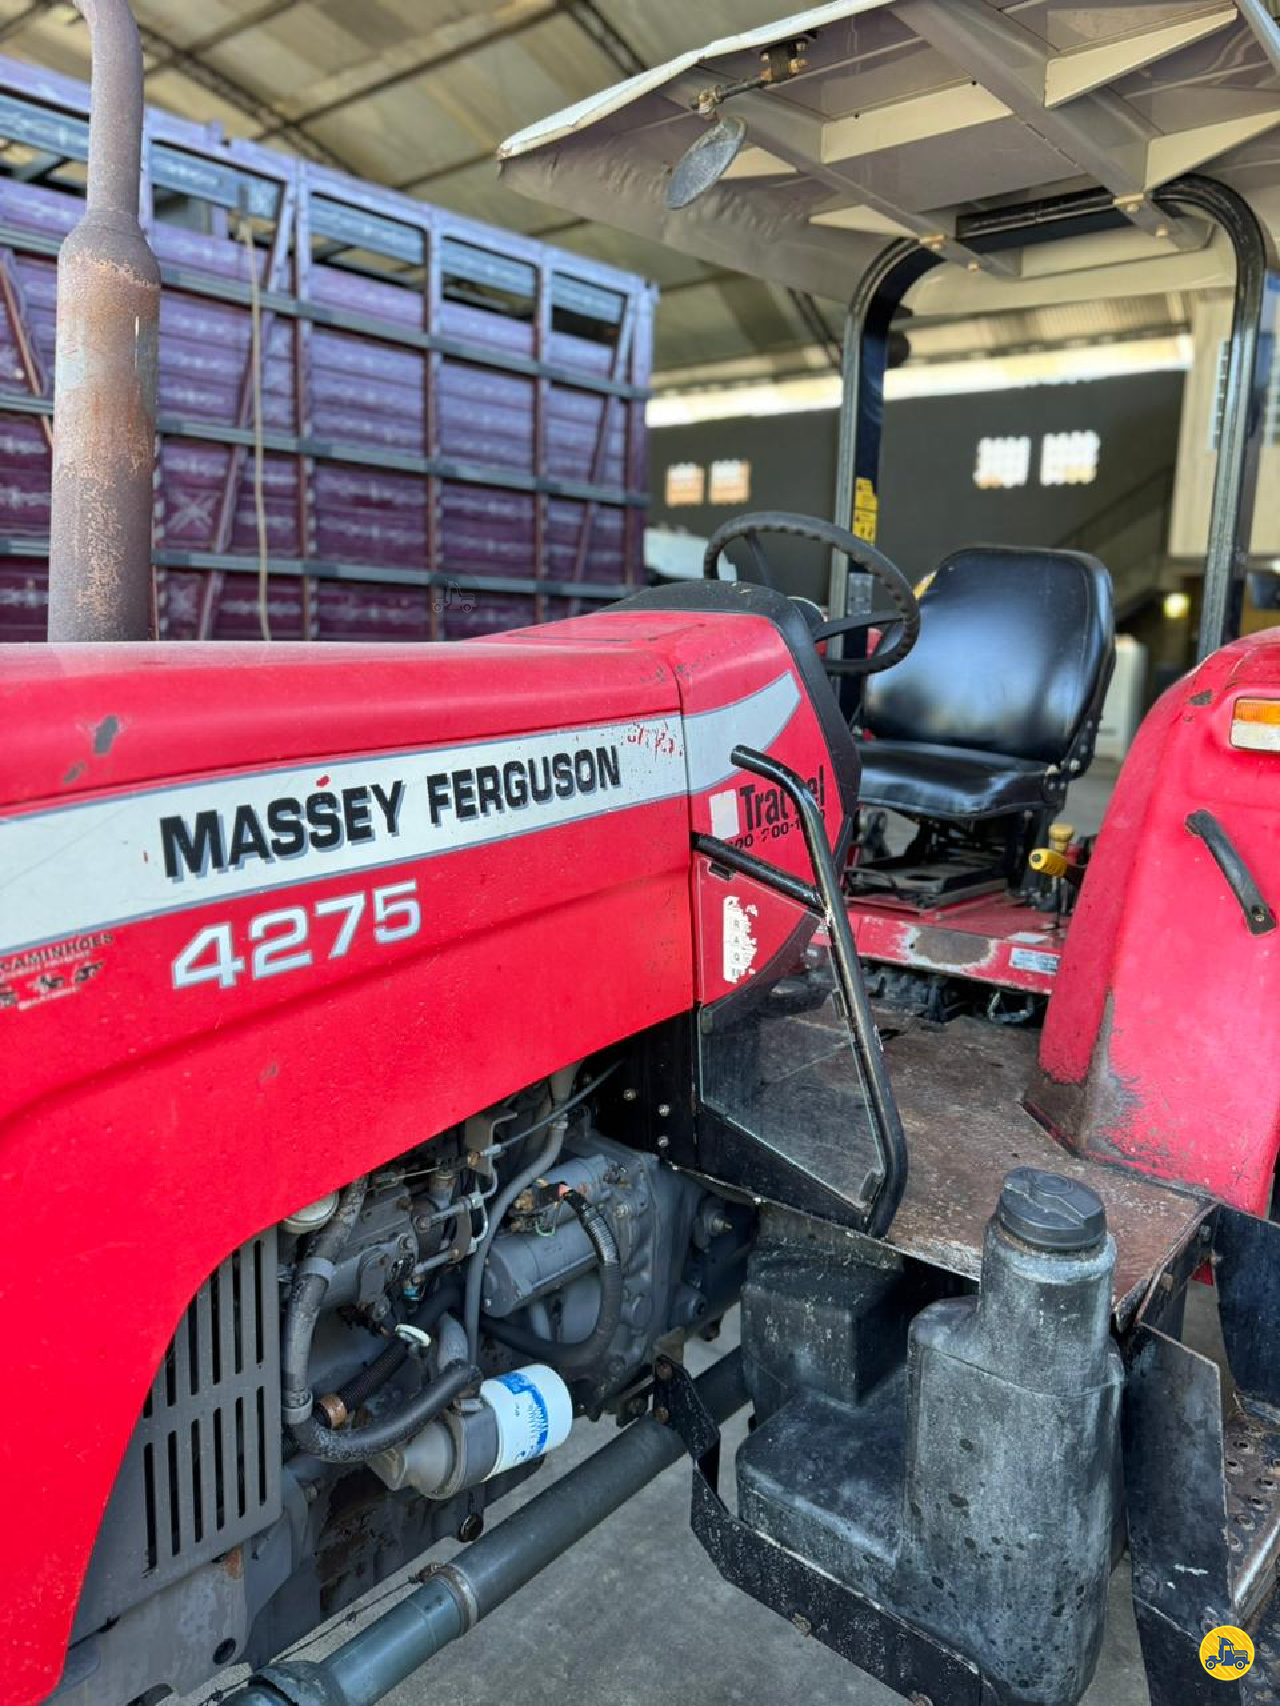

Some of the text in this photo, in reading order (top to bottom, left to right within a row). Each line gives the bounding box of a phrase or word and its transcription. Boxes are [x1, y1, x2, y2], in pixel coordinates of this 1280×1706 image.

[158, 745, 622, 882] MASSEY FERGUSON
[171, 879, 422, 991] 4275
